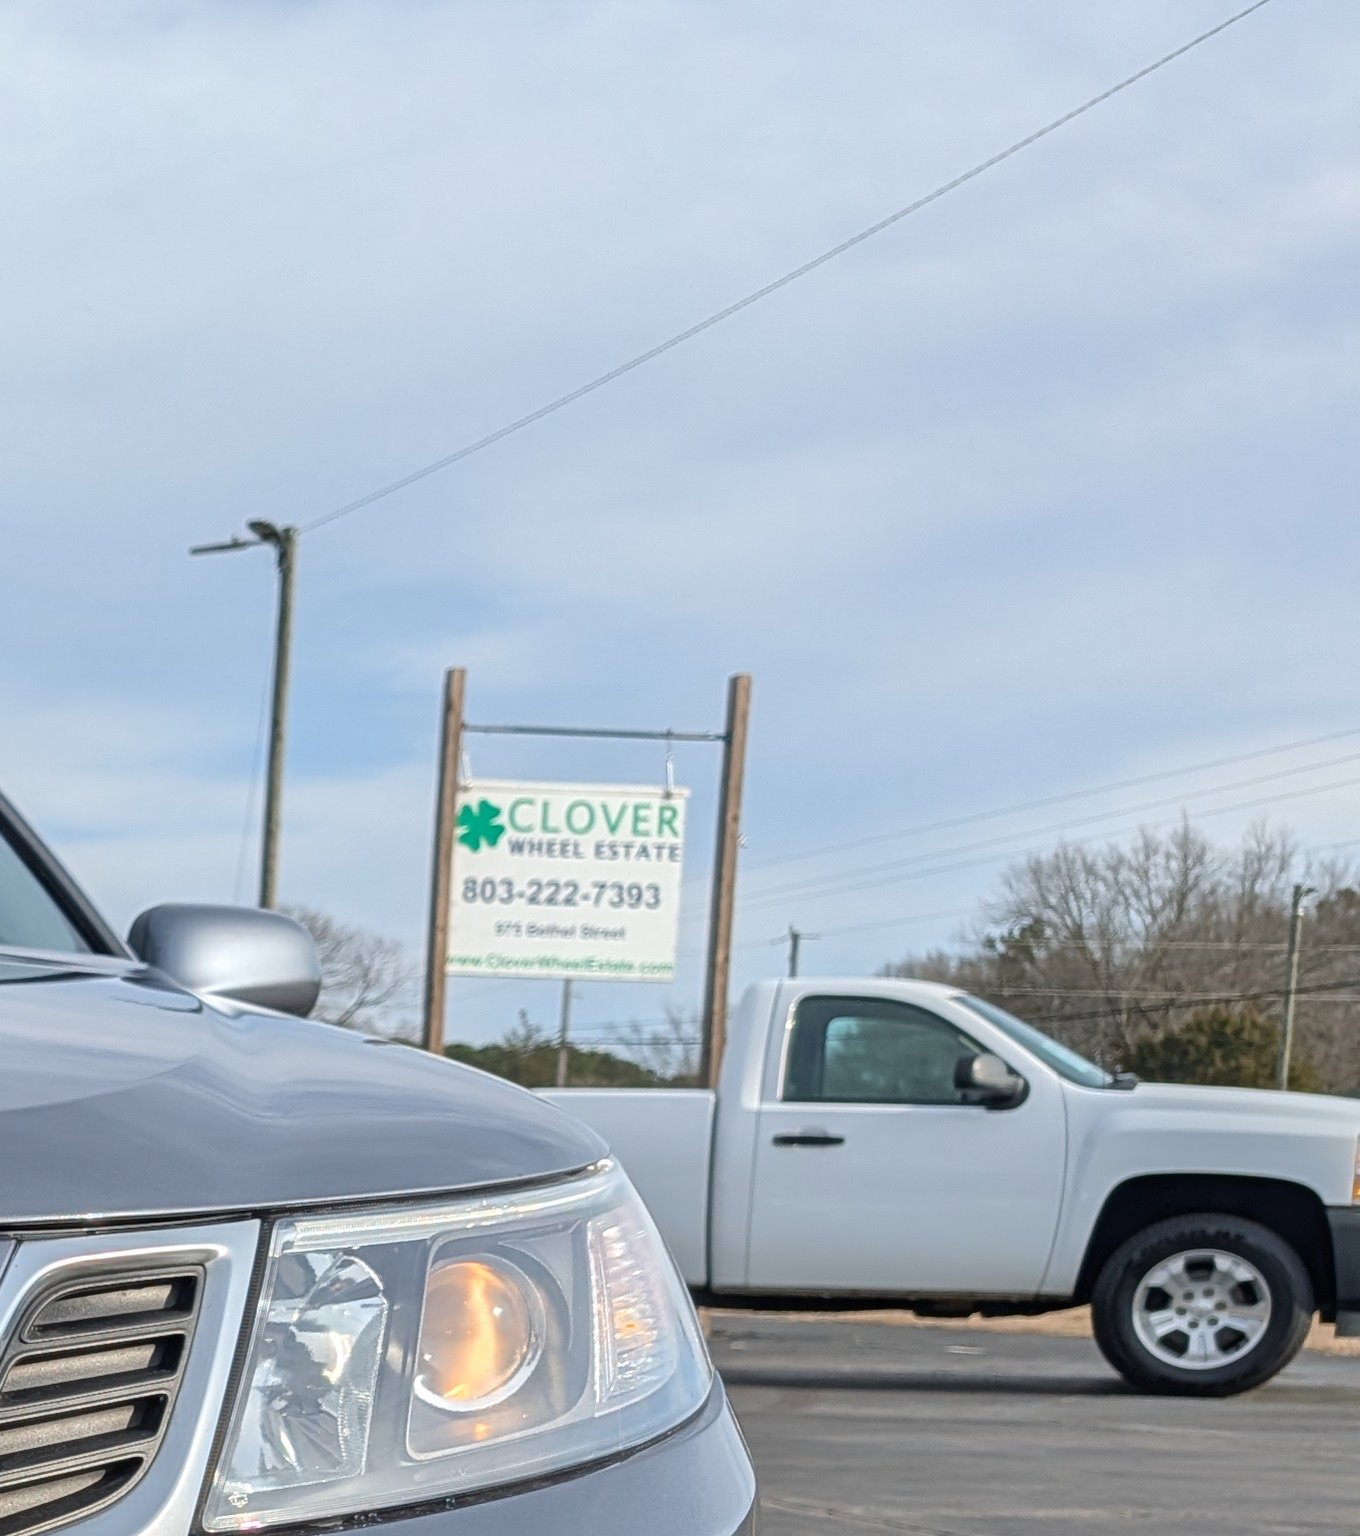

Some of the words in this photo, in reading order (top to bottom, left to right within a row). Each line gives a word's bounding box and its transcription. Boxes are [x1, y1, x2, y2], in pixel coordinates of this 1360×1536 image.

[508, 798, 680, 838] CLOVER
[508, 838, 586, 859] WHEEL
[594, 842, 682, 863] ESTATE
[462, 876, 662, 909] 803-222-7393
[525, 921, 576, 938] Bethel
[580, 923, 627, 940] Street
